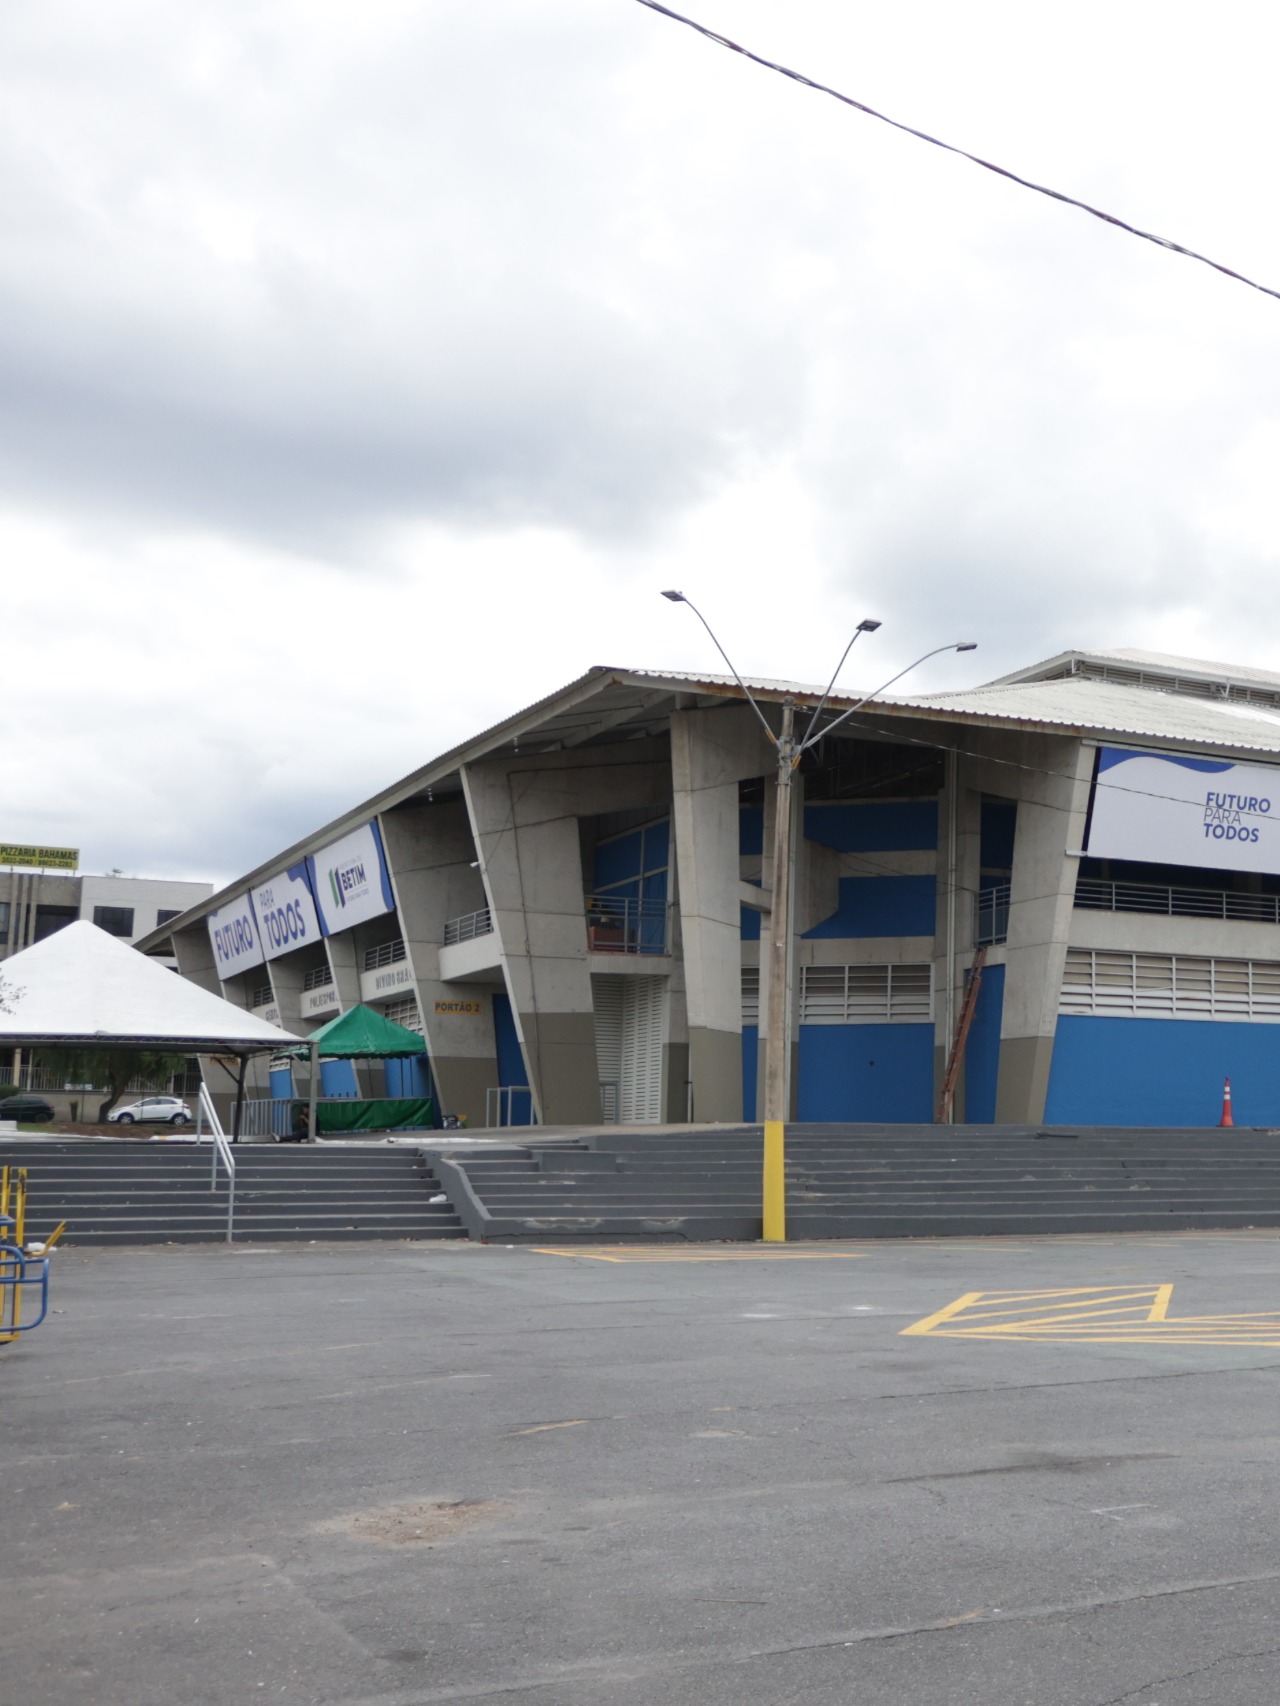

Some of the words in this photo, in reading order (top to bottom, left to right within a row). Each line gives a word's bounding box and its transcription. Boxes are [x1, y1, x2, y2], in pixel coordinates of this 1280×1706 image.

[1206, 791, 1271, 814] FUTURO
[1203, 807, 1242, 826] PARA
[1203, 823, 1260, 843] TODOS
[1, 846, 36, 857] PIZZARIA
[38, 849, 77, 860] BAHAMAS
[341, 862, 367, 892] BETIM
[259, 886, 275, 912] PARA
[263, 898, 306, 950] TODOS
[214, 914, 253, 963] FUTURO
[435, 1001, 472, 1012] PORTÃO
